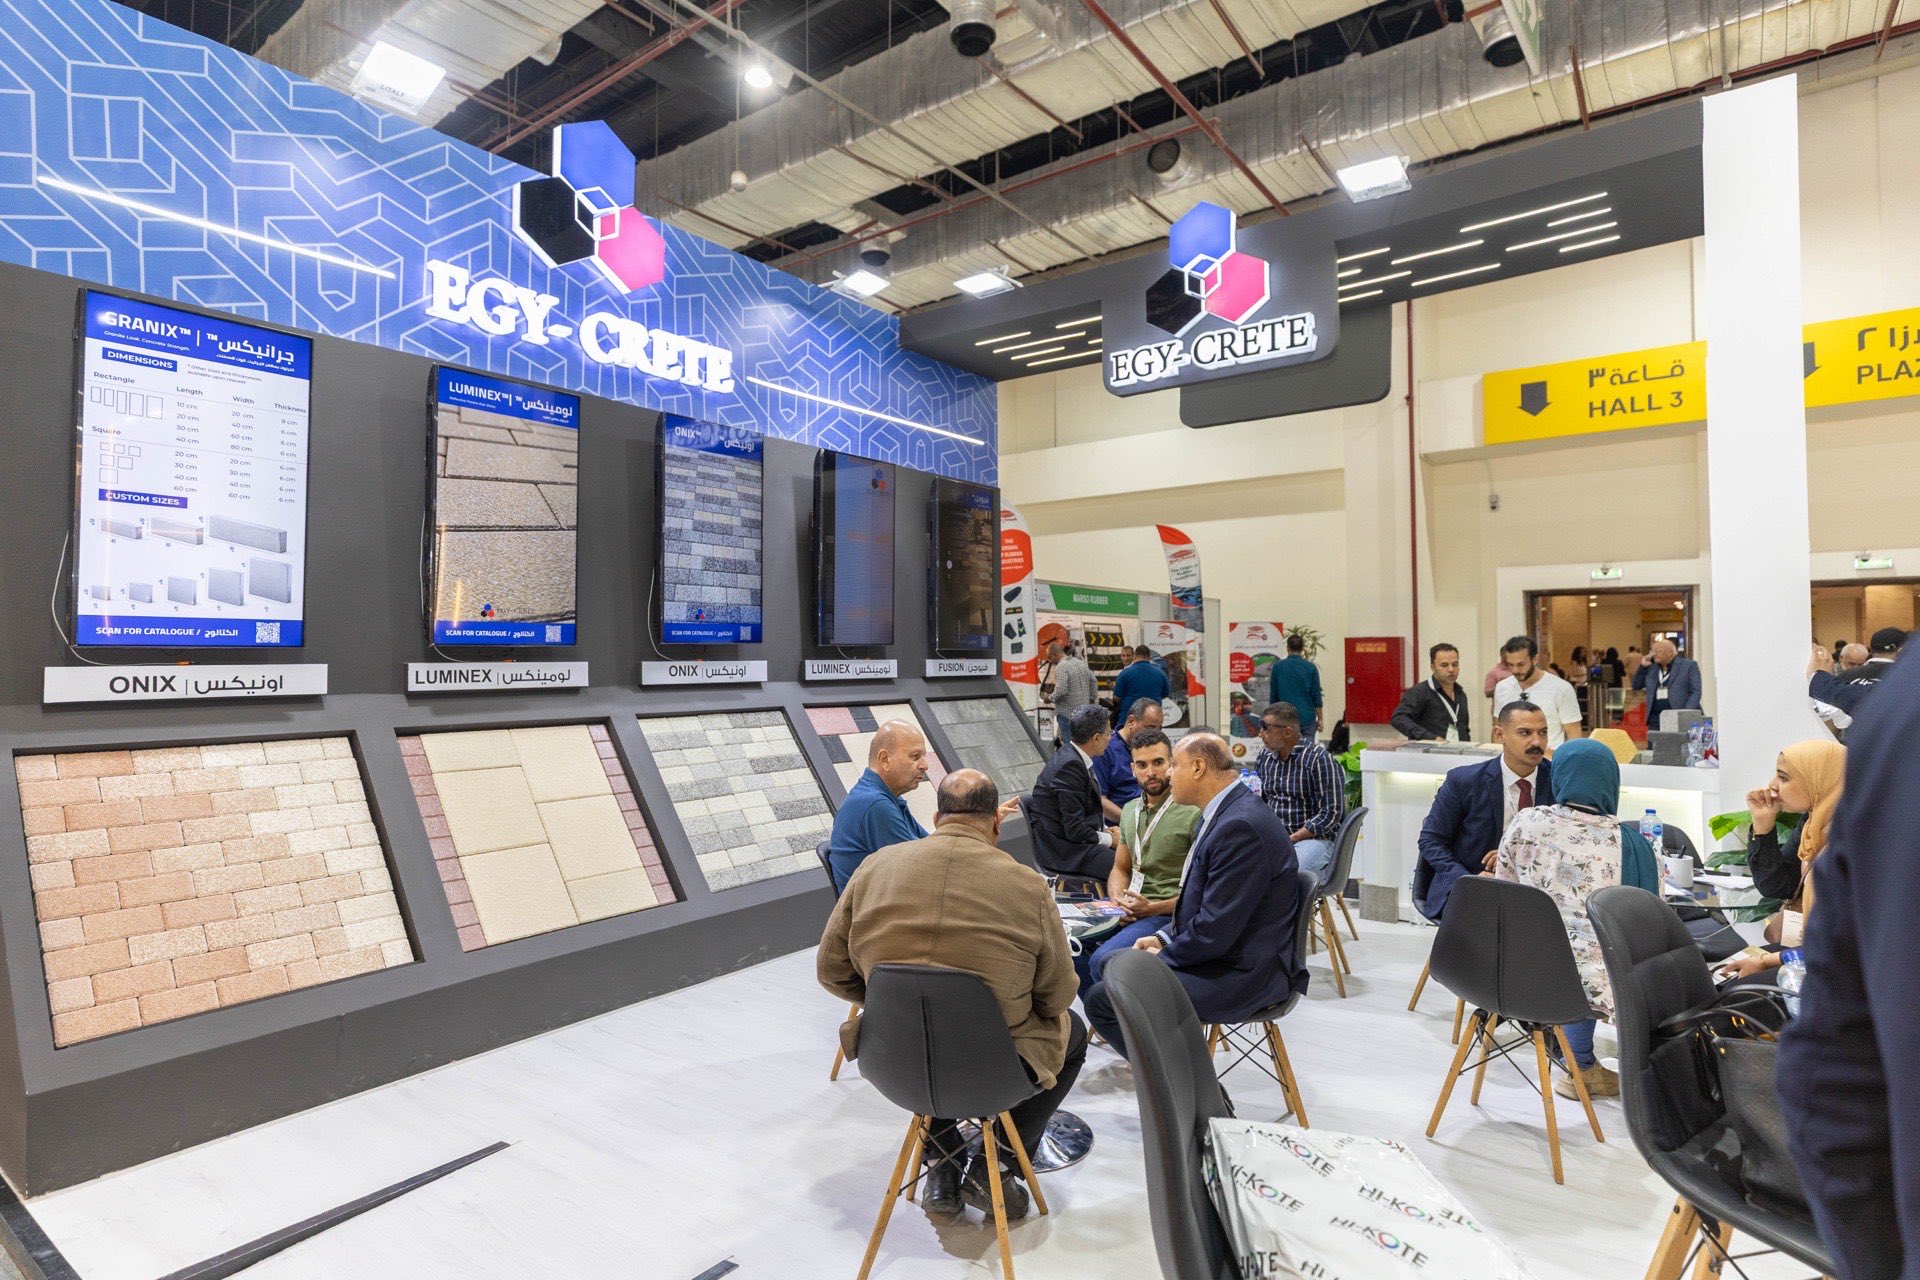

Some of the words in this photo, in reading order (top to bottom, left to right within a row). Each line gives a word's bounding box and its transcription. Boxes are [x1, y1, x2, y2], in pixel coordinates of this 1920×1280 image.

[425, 259, 734, 393] EGY-CRETE
[1110, 312, 1316, 386] EGY-CRETE
[108, 350, 173, 369] DIMENSIONS
[94, 372, 136, 384] Rectangle
[176, 386, 203, 396] Length
[232, 396, 255, 405] Width
[1589, 393, 1663, 418] HALL
[1670, 391, 1683, 408] 3
[274, 403, 307, 414] Thickness
[92, 426, 121, 436] Square
[106, 492, 150, 503] CUSTOM
[152, 496, 180, 506] SIZES
[144, 628, 194, 636] CATALOGUE
[205, 630, 238, 638] الكتالوج
[669, 665, 698, 677] ONIX
[706, 665, 746, 678] اونيكس
[812, 664, 850, 674] LUMINEX
[855, 664, 890, 675] لومينكس
[938, 663, 964, 672] FUSION
[968, 664, 988, 673] فيوجن
[415, 669, 492, 685] LUMINEX
[502, 669, 571, 685] لومينكس
[109, 675, 177, 694] ONIX
[194, 674, 283, 695] اونيكس
[1329, 1216, 1429, 1268] HI-KOTE
